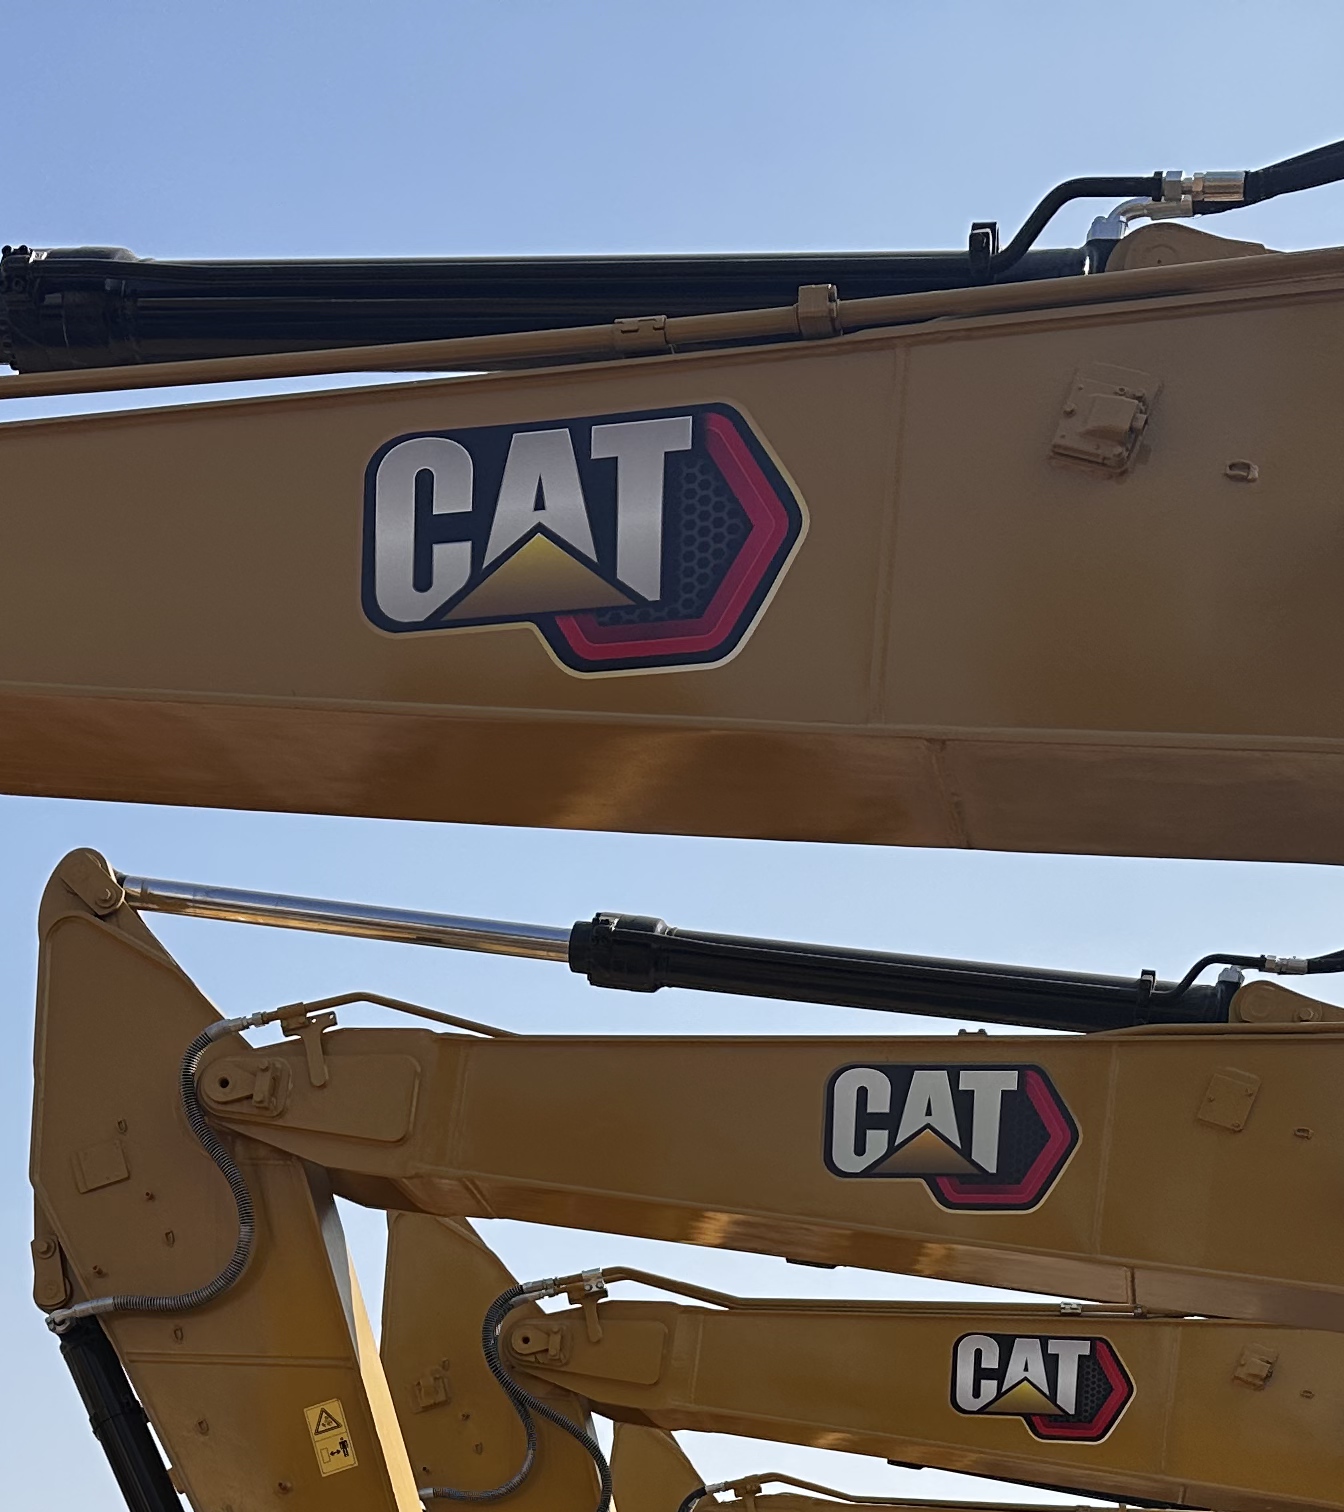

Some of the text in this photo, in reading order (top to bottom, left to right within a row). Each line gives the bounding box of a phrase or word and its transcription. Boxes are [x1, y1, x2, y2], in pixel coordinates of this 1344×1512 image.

[375, 415, 693, 622] CAT
[831, 1067, 1019, 1174] CAT
[956, 1334, 1090, 1415] CAT
